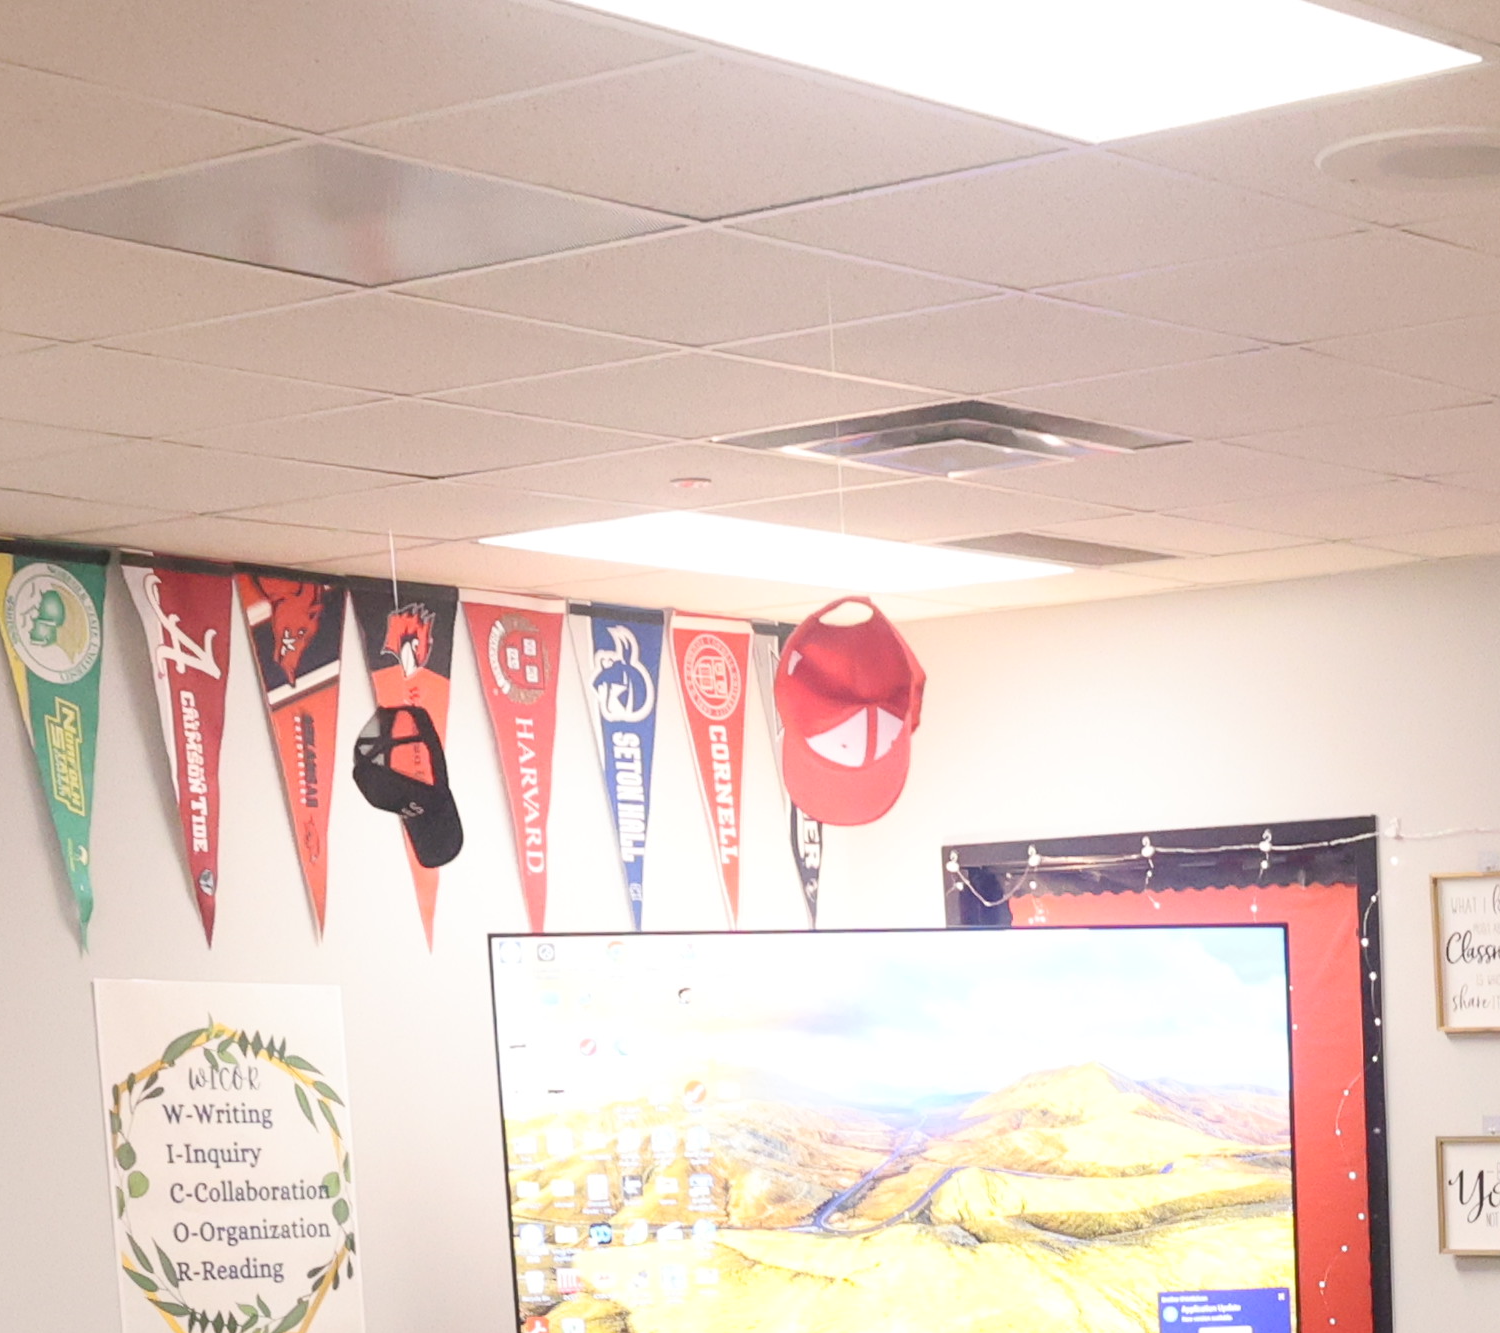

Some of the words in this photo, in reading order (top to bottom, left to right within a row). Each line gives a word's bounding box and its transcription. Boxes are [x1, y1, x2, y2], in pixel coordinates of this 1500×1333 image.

[180, 690, 208, 794] CRIMSON
[612, 731, 644, 803] SETON
[515, 717, 546, 875] HARVARD
[708, 724, 739, 865] CORNELL
[191, 797, 209, 853] TIDE
[617, 803, 646, 863] HALL
[802, 808, 822, 869] ER
[1451, 897, 1477, 914] WHAT
[1452, 984, 1489, 1012] share
[188, 1066, 261, 1092] WICOR
[162, 1103, 274, 1129] W-Writing
[166, 1143, 262, 1168] I-Inquiry
[169, 1180, 331, 1204] C-Collaboration
[173, 1221, 332, 1247] O-Organization
[176, 1261, 285, 1284] R-Reading
